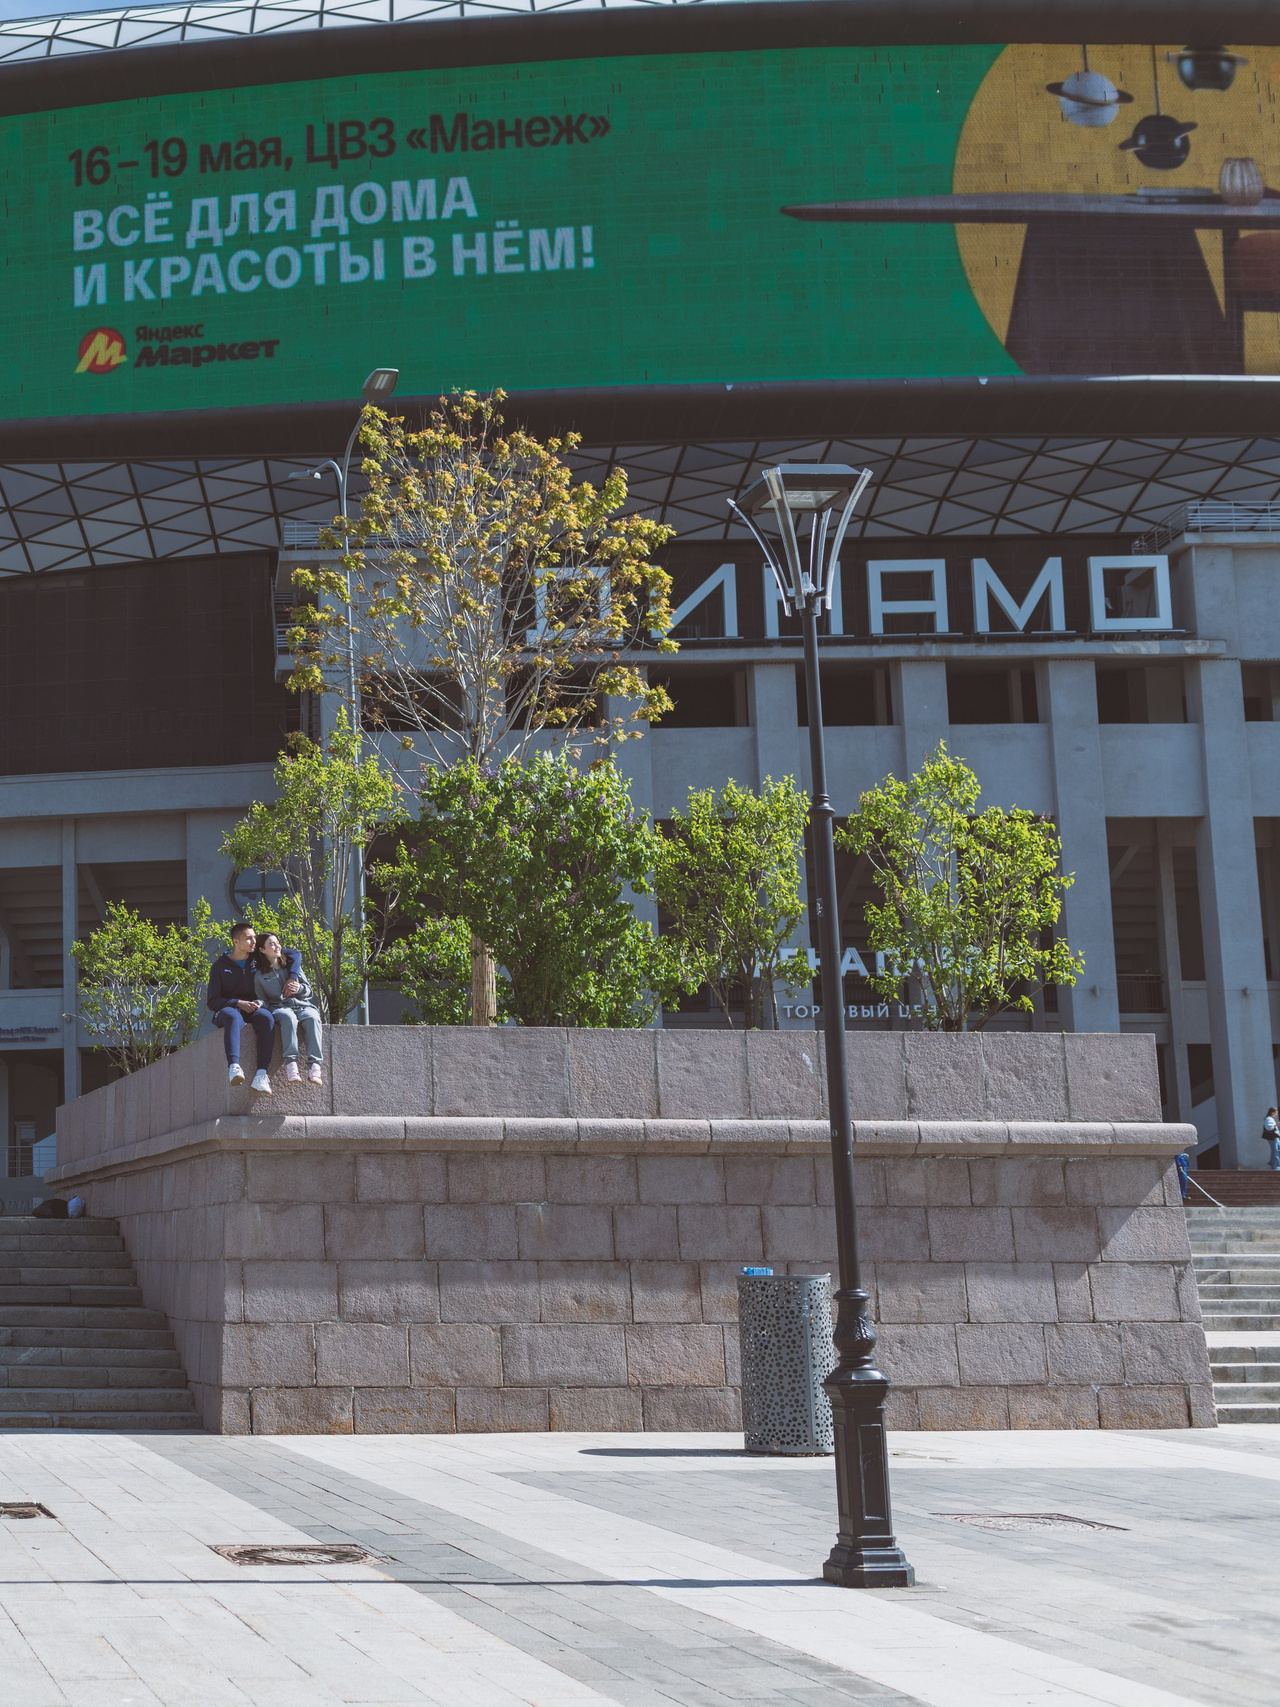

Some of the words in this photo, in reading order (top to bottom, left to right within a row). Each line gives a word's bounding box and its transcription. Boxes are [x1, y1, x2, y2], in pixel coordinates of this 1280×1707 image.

[199, 136, 294, 174] мая,
[405, 112, 612, 155] «Манеж»
[73, 191, 175, 252] ВСЁ
[185, 189, 297, 250] ДЛЯ
[310, 176, 479, 238] ДОМА
[73, 263, 108, 308] И
[123, 238, 387, 302] КРАСОТЫ
[402, 235, 438, 279] В
[451, 219, 596, 277] НЁМ!
[133, 339, 281, 368] Маркет
[135, 324, 205, 344] Яндекс
[783, 1002, 889, 1018] ТОРВЫЙ
